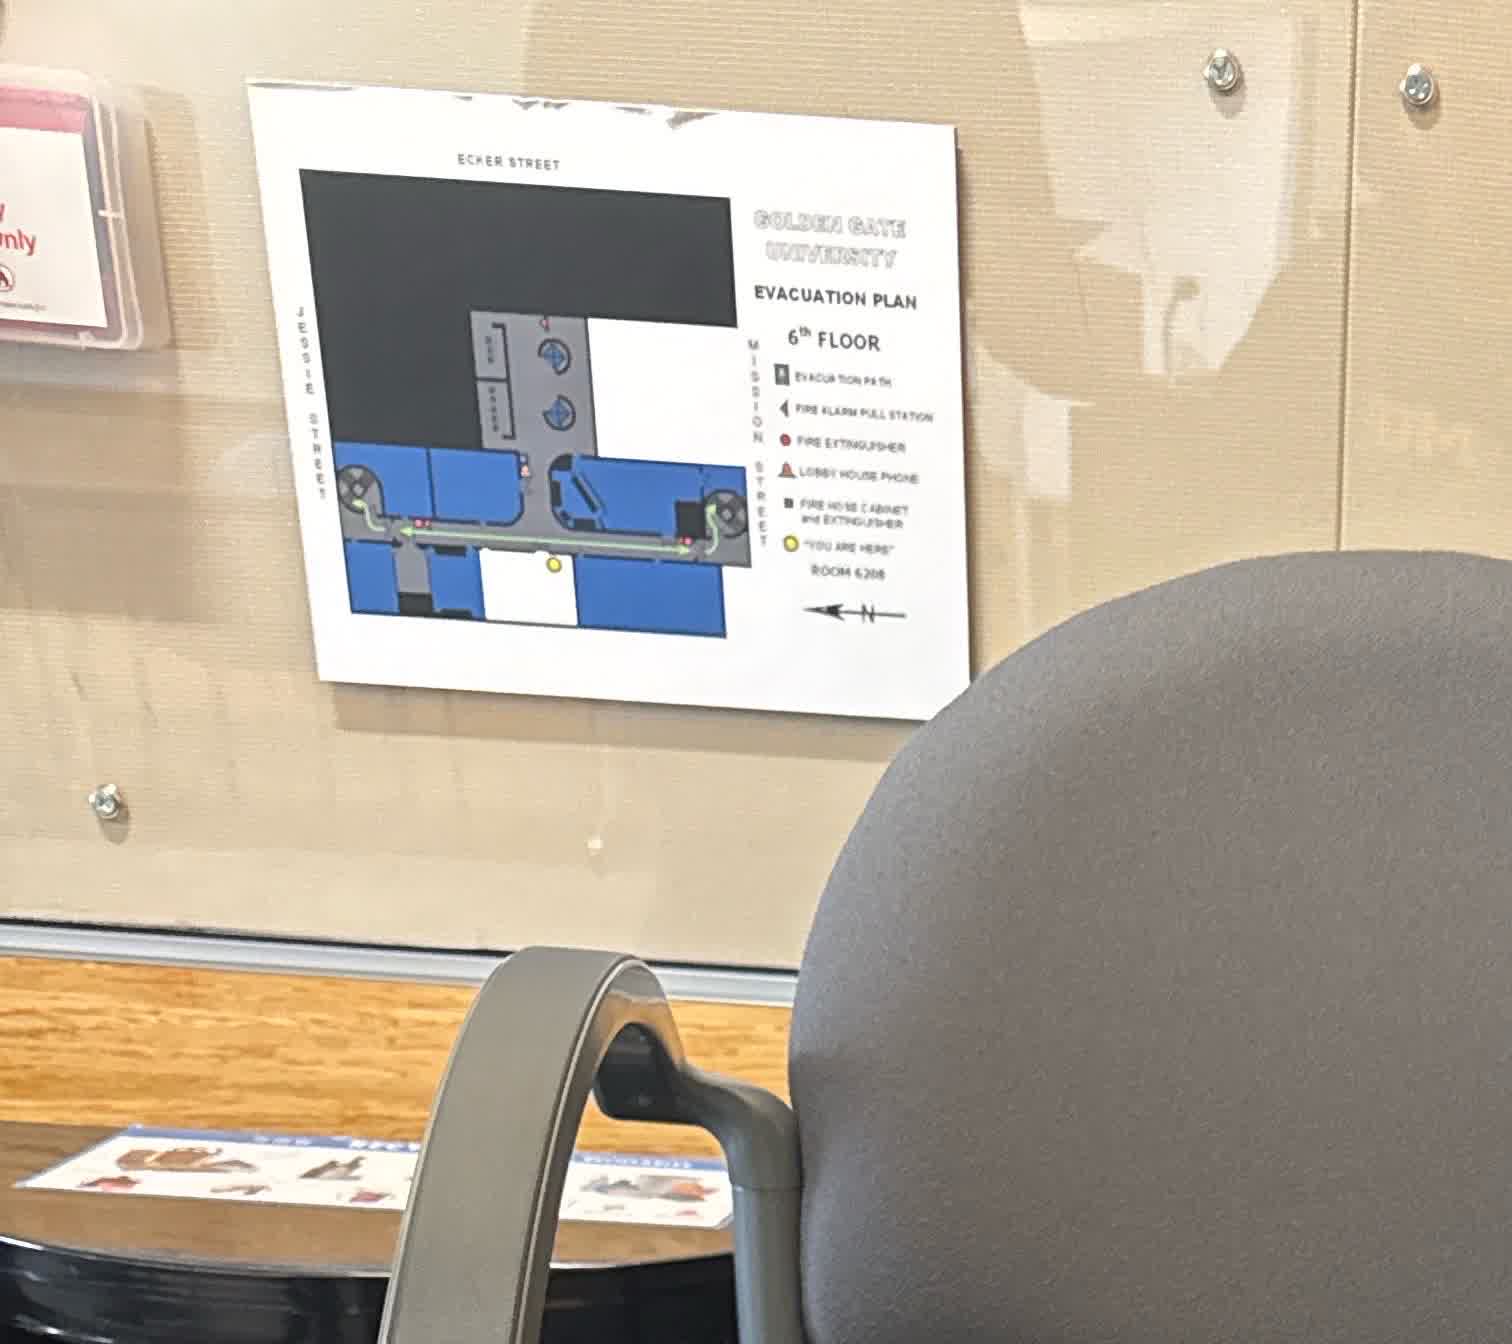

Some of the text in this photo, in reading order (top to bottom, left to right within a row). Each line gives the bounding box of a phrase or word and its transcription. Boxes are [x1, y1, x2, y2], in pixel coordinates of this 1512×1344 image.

[457, 153, 561, 171] ECKER STREET
[753, 209, 907, 239] GOLDEN GATE
[765, 240, 898, 269] UNIVERSITY
[754, 284, 918, 311] EVACUATION PLAN
[787, 326, 881, 352] 6th FLOOR
[795, 403, 935, 424] FIRE ALARM PULL STATION
[748, 338, 768, 548] MISSION STREET
[796, 435, 907, 455] FIRE EXTINGUISHER
[798, 465, 837, 479] LOBBY
[880, 471, 921, 486] PHONE
[799, 498, 825, 511] FIRE
[834, 541, 857, 554] ARE
[810, 563, 852, 578] ROOM
